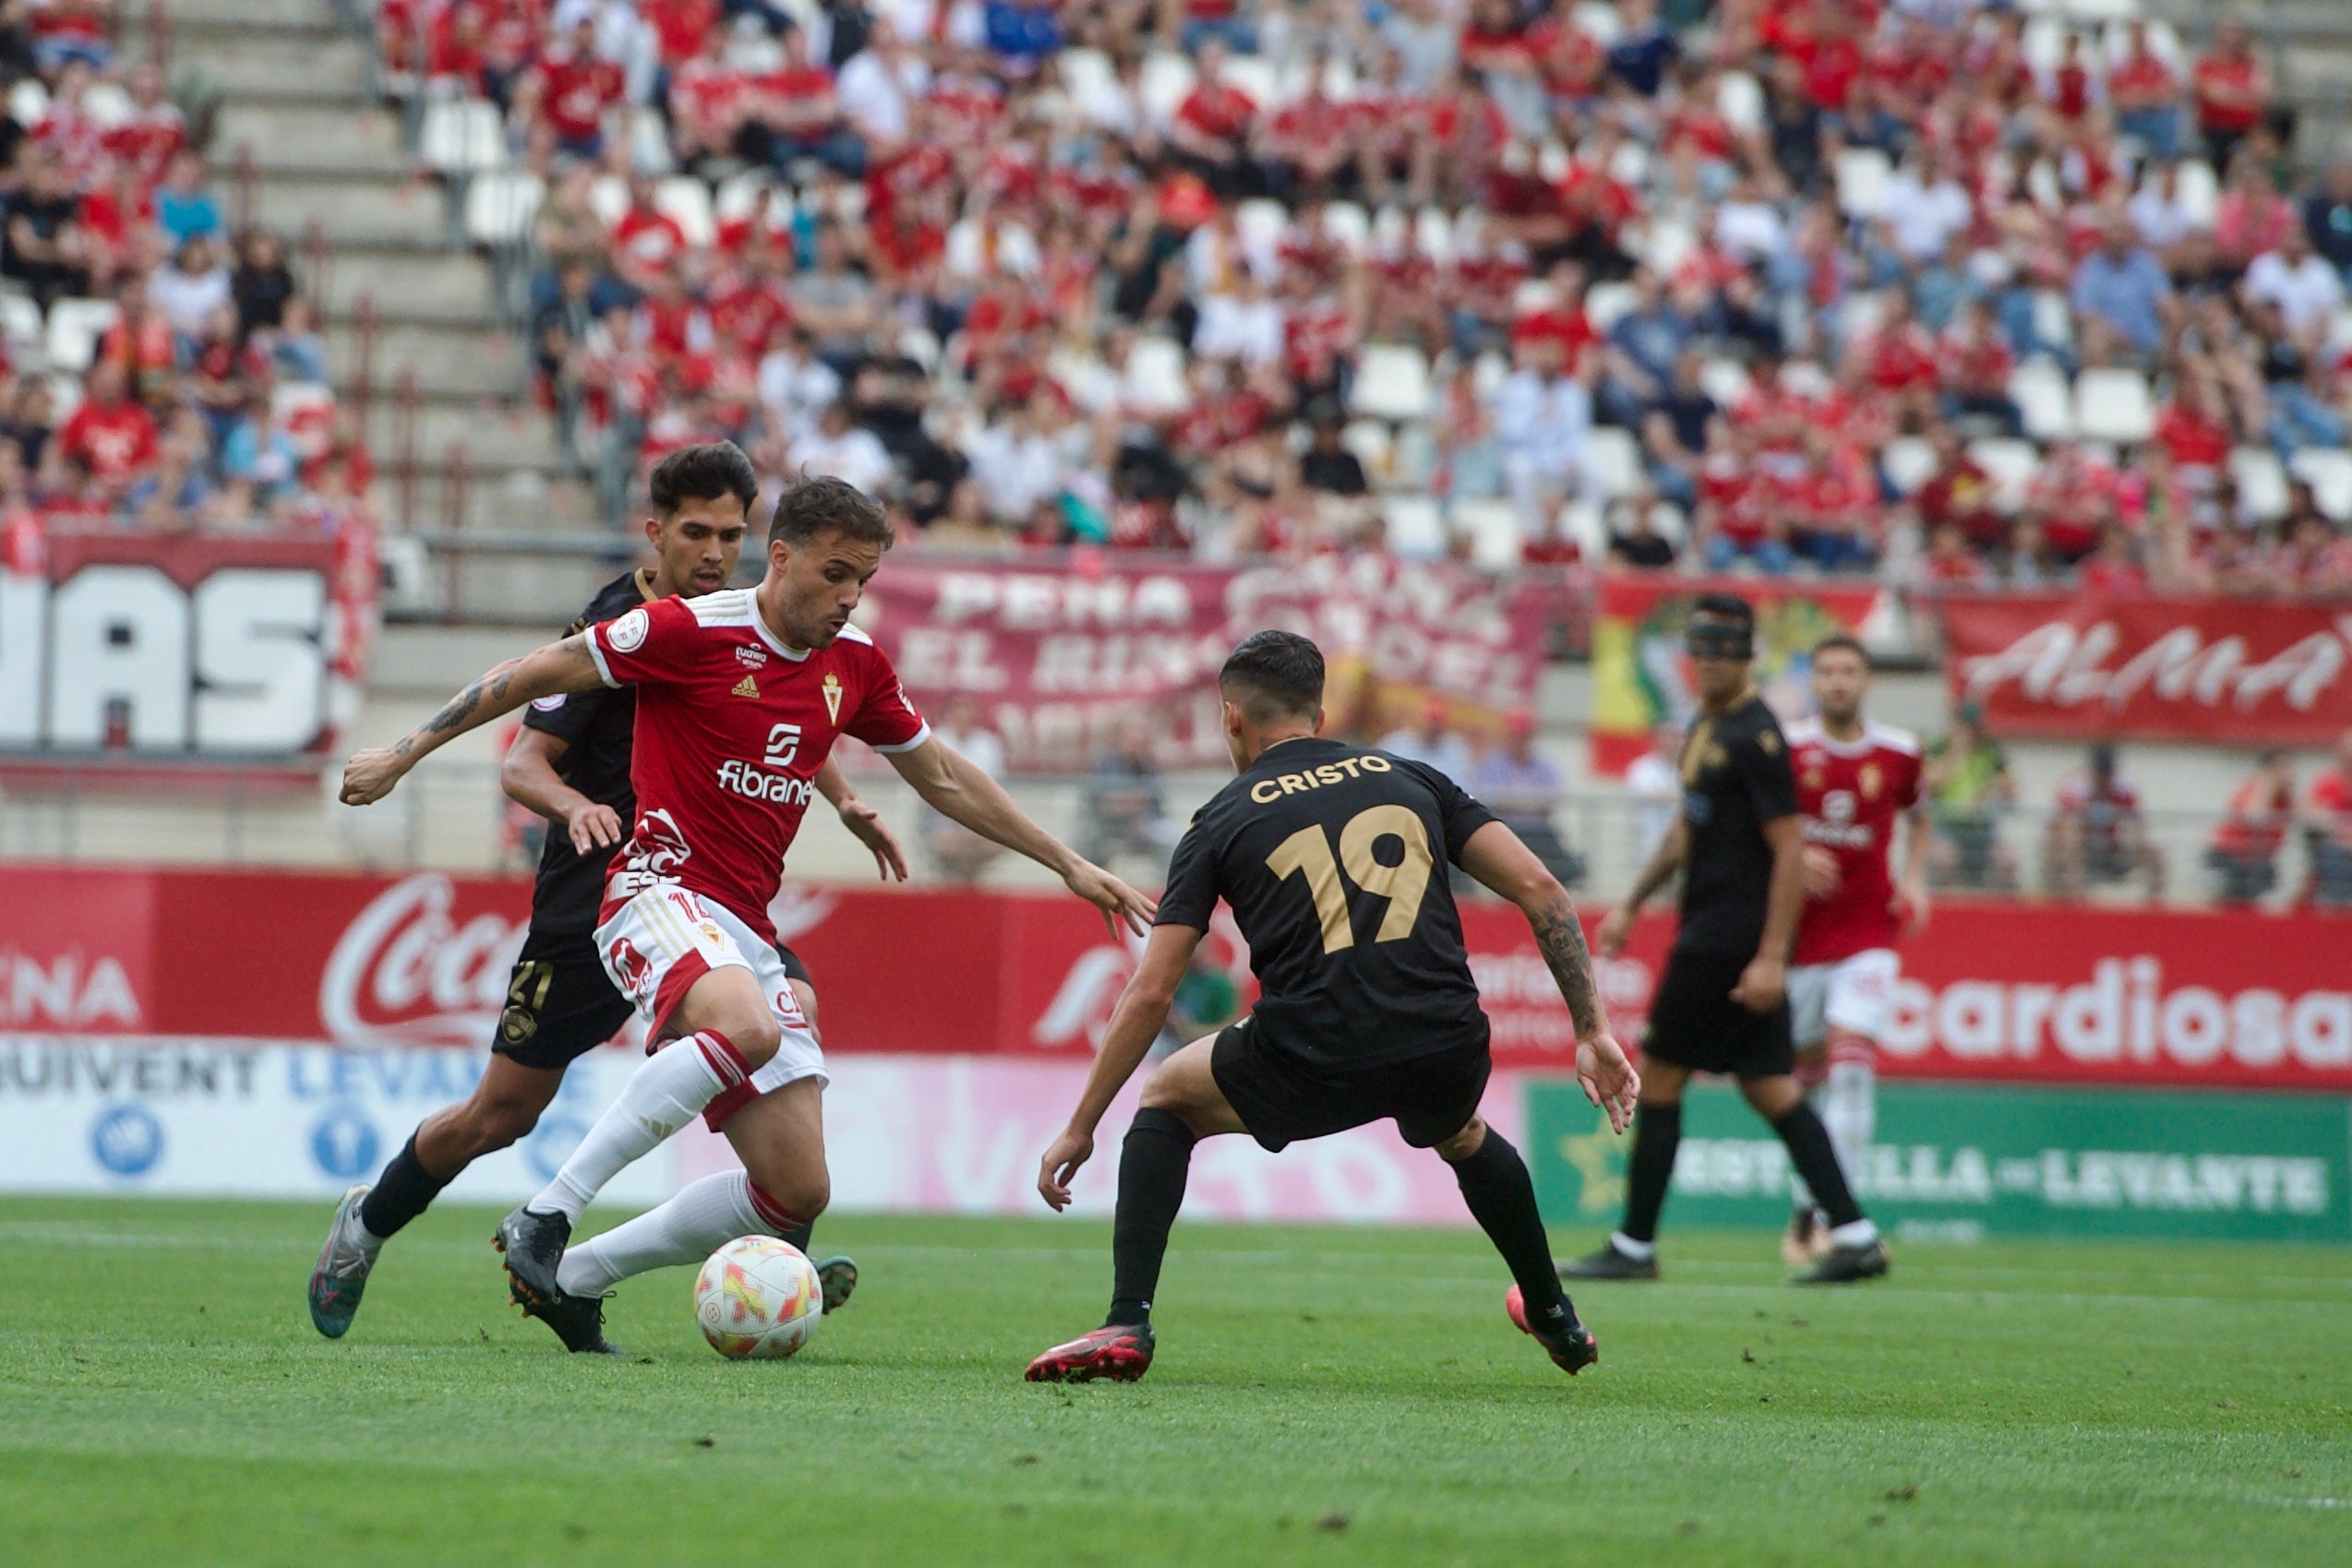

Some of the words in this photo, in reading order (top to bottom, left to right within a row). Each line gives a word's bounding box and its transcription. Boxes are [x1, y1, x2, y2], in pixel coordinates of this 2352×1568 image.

[716, 759, 816, 807] fibrane
[1250, 755, 1392, 805] CRISTO
[1266, 804, 1434, 955] 19
[0, 1040, 260, 1100] UIVENT
[2040, 1149, 2330, 1215] LEVANTE
